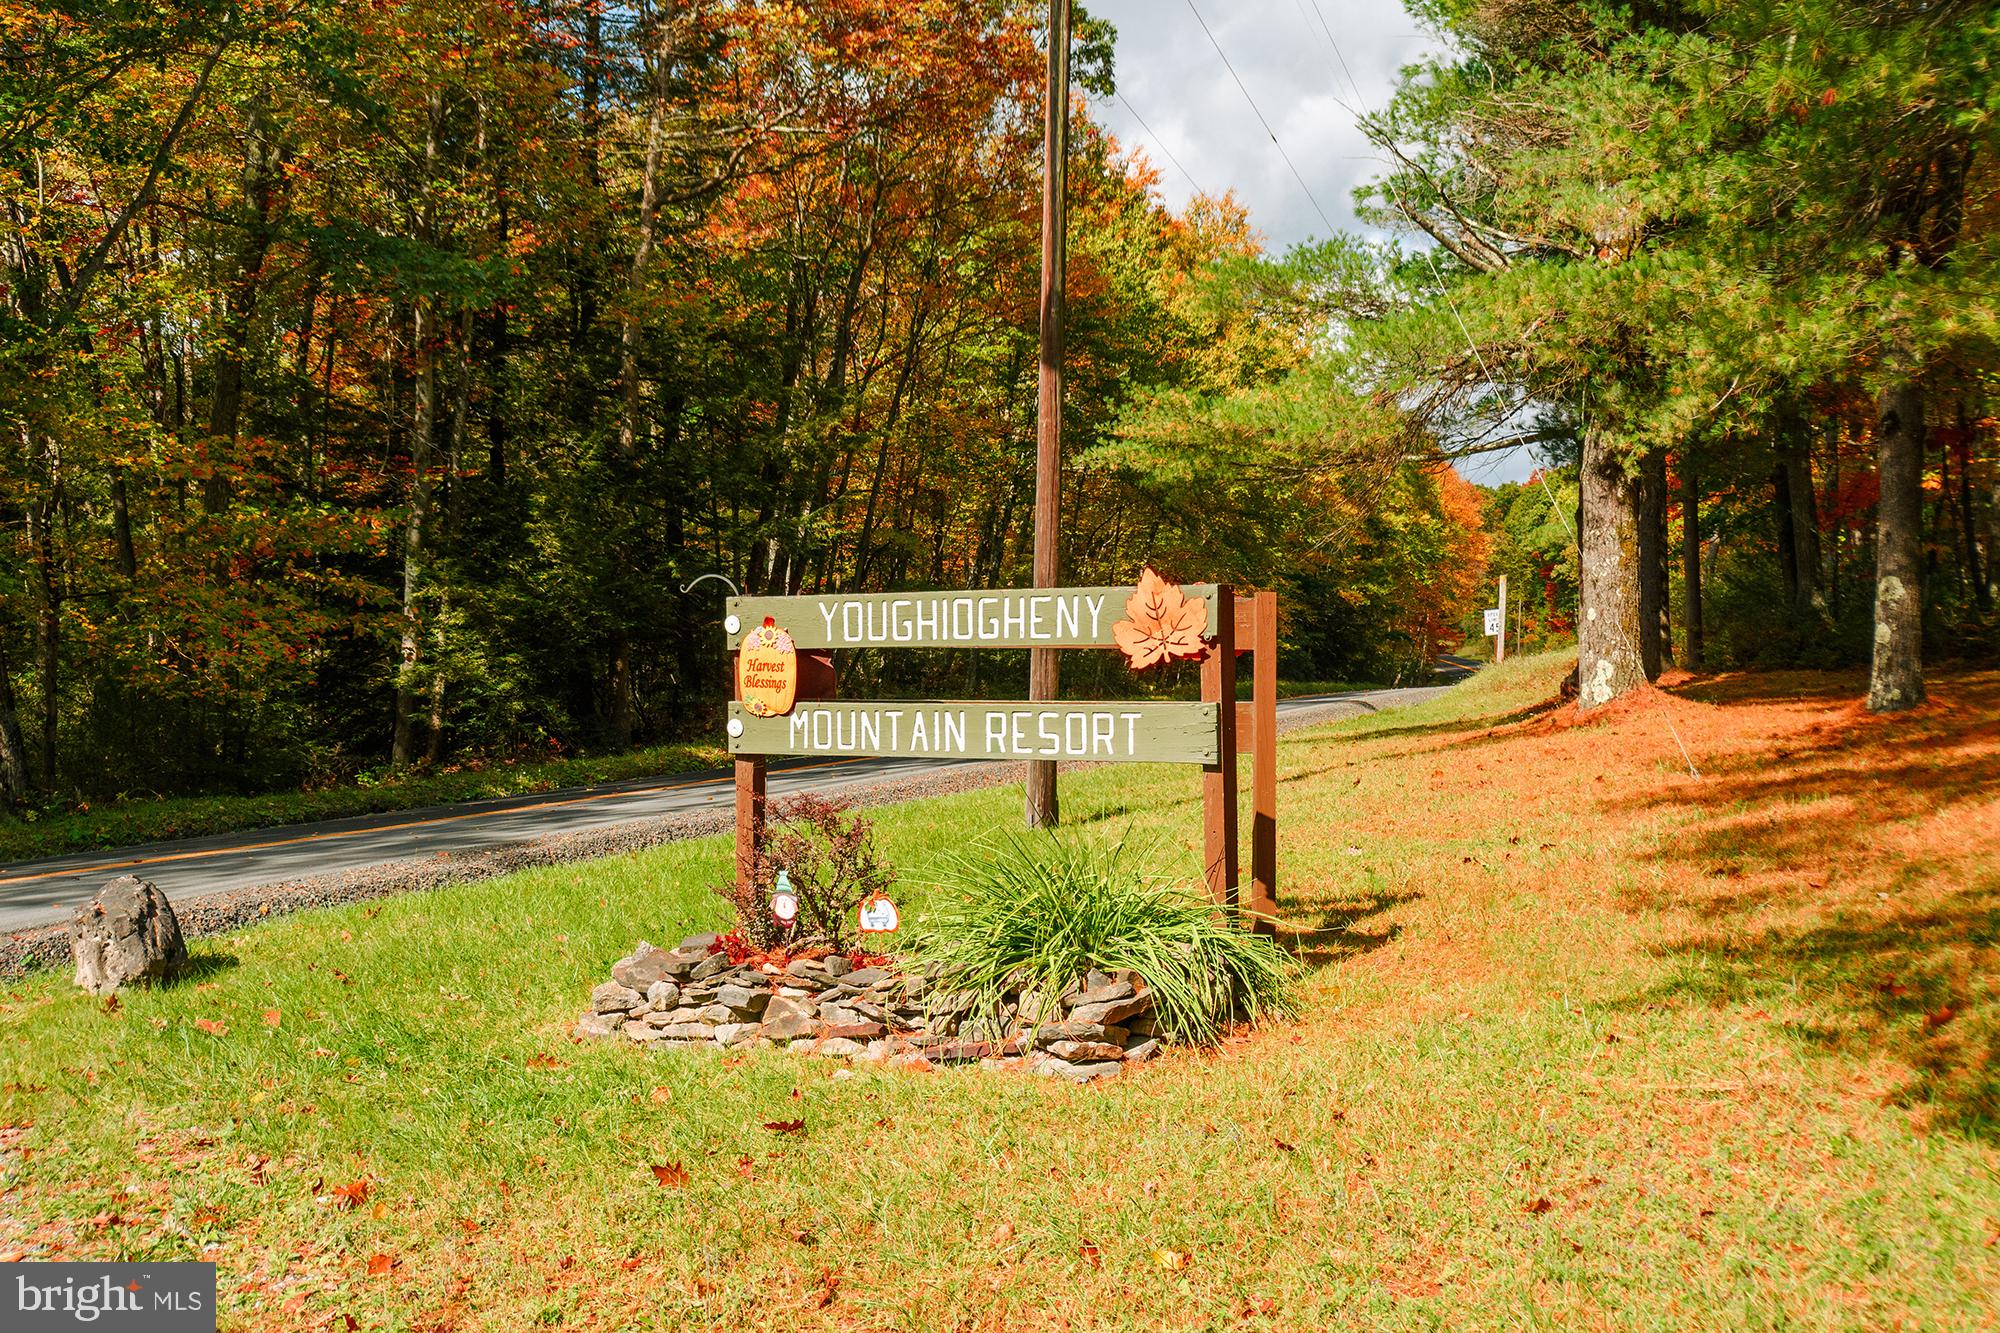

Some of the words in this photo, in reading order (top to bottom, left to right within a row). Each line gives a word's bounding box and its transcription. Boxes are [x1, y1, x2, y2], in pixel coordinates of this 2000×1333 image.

[818, 595, 1105, 642] YOUGHIOGHENY
[747, 658, 785, 673] Harvest
[744, 674, 787, 694] Blessings
[789, 709, 966, 751] MOUNTAIN
[984, 711, 1142, 755] RESORT
